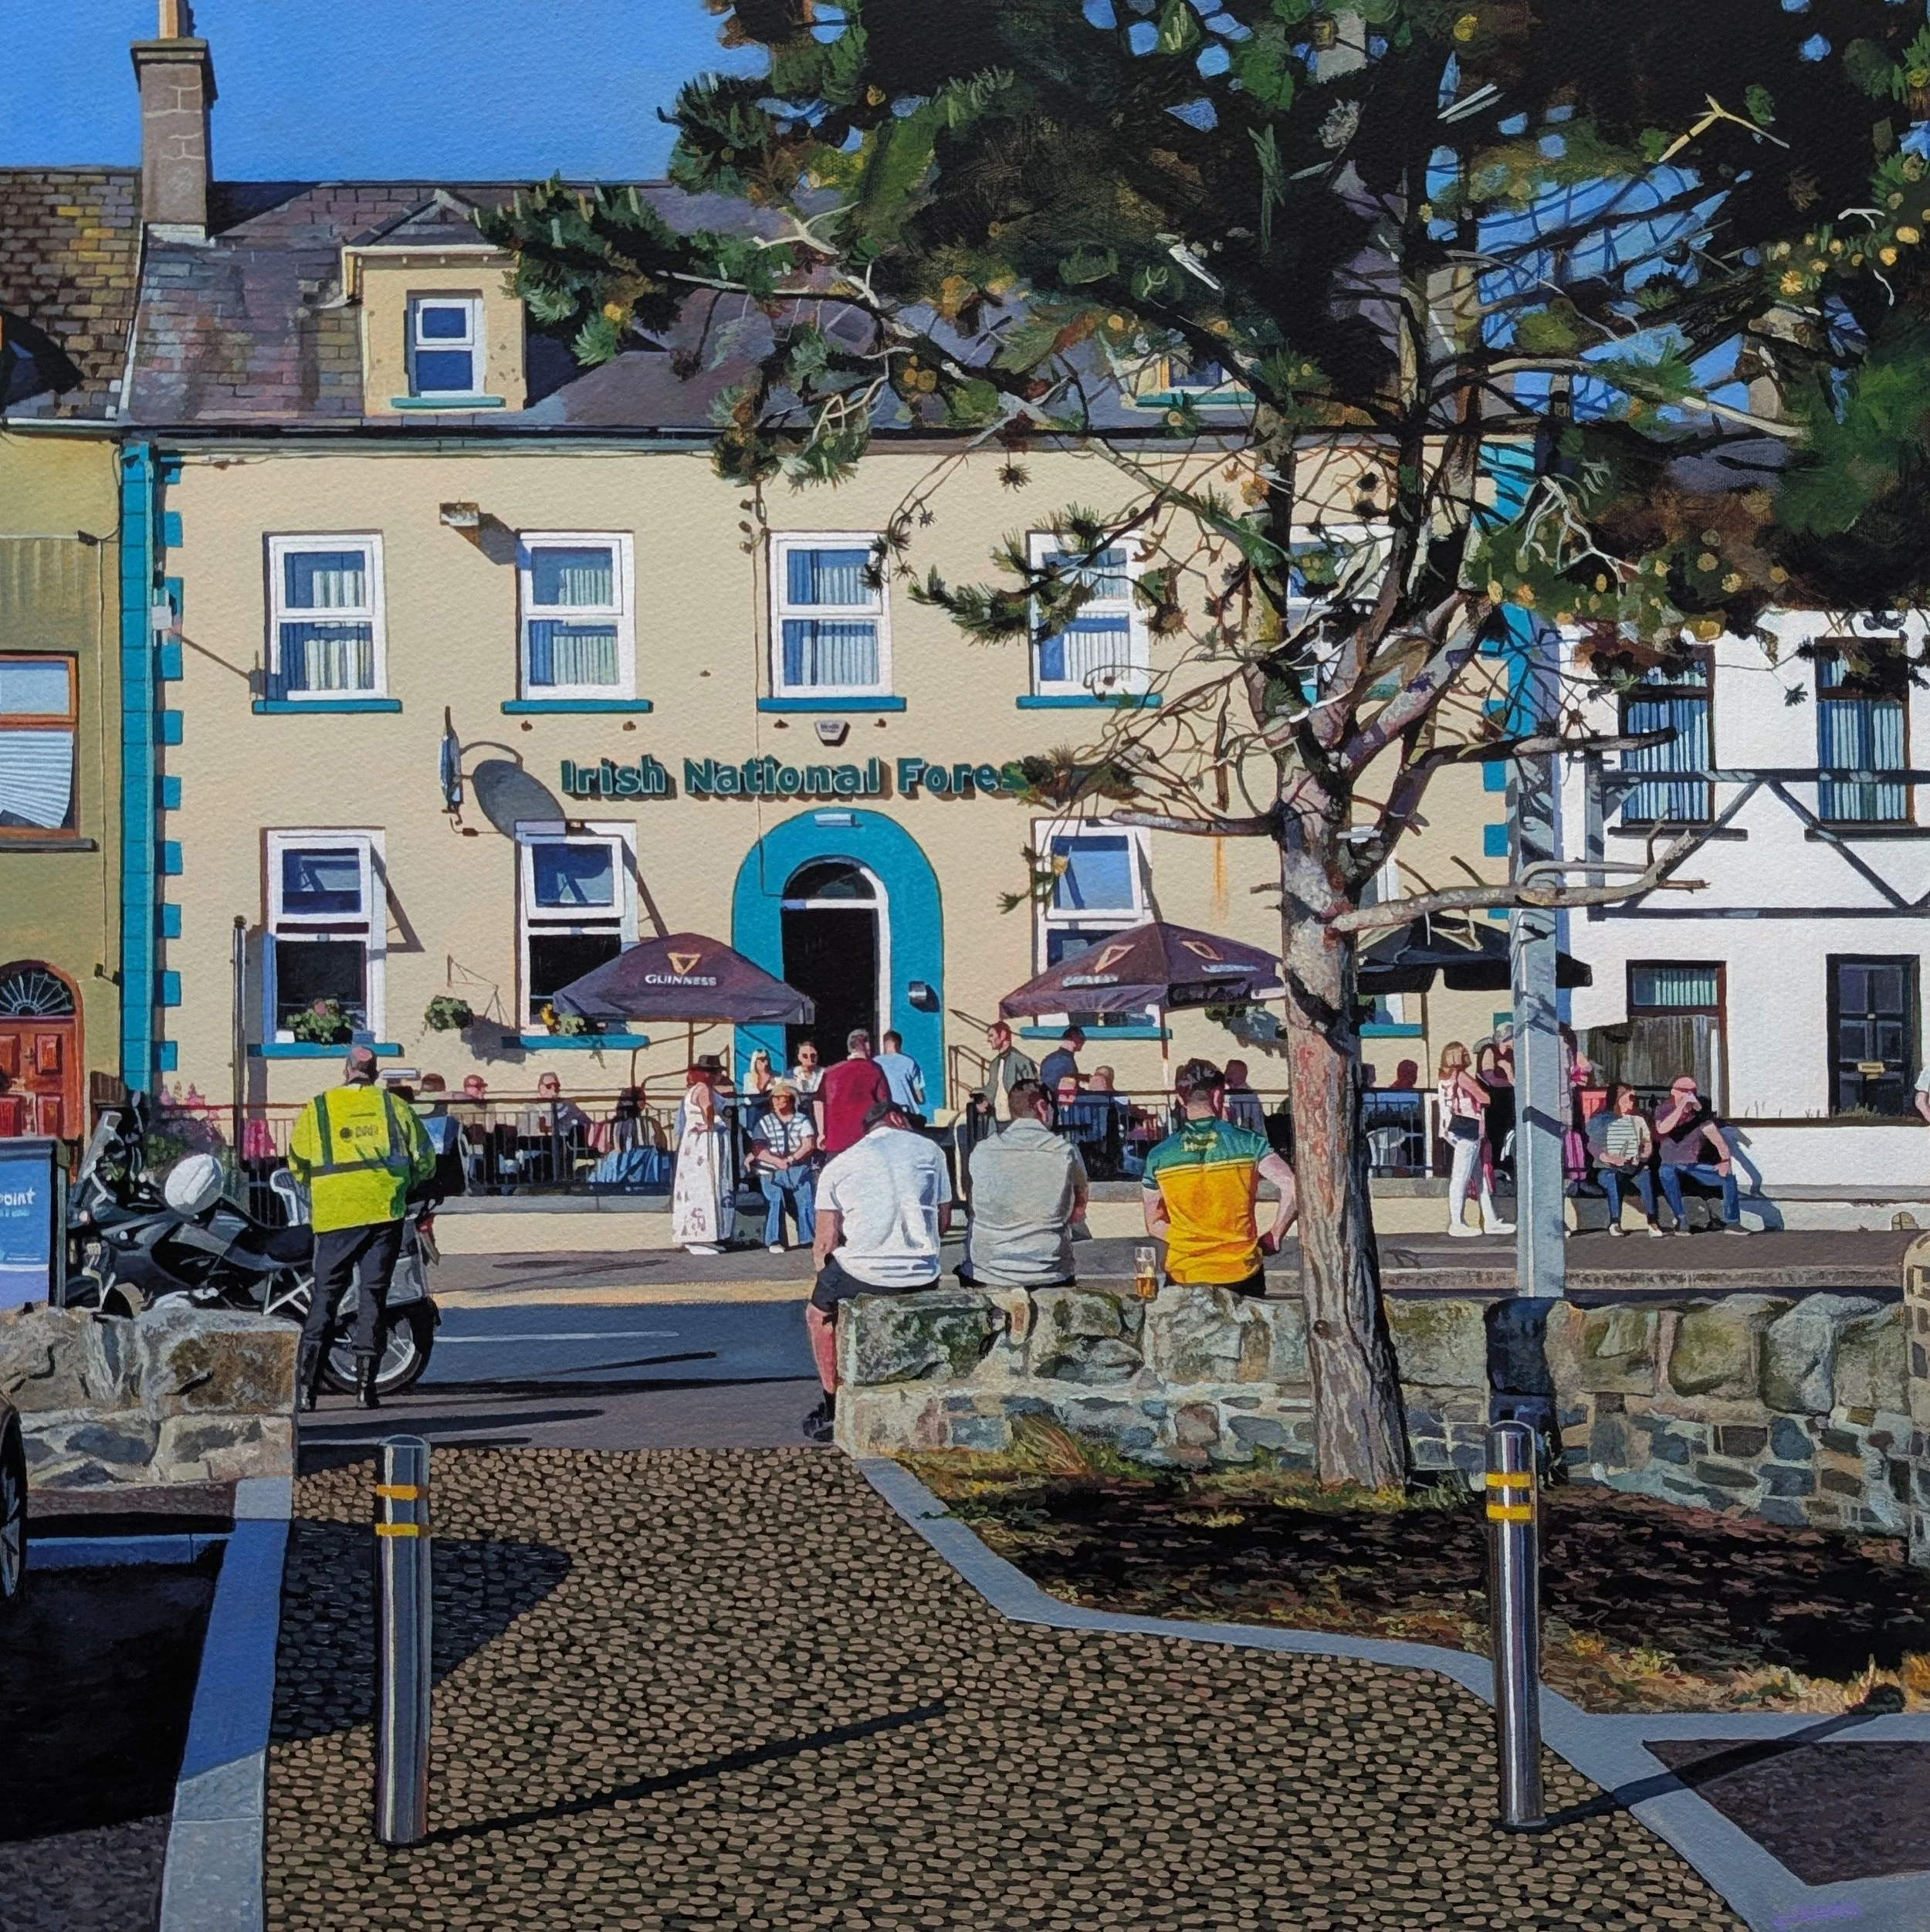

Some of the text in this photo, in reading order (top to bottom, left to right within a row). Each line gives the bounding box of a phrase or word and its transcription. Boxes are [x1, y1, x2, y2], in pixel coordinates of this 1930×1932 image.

[560, 754, 667, 795] Irish
[683, 754, 880, 795] National
[645, 974, 717, 986] GUINNESS
